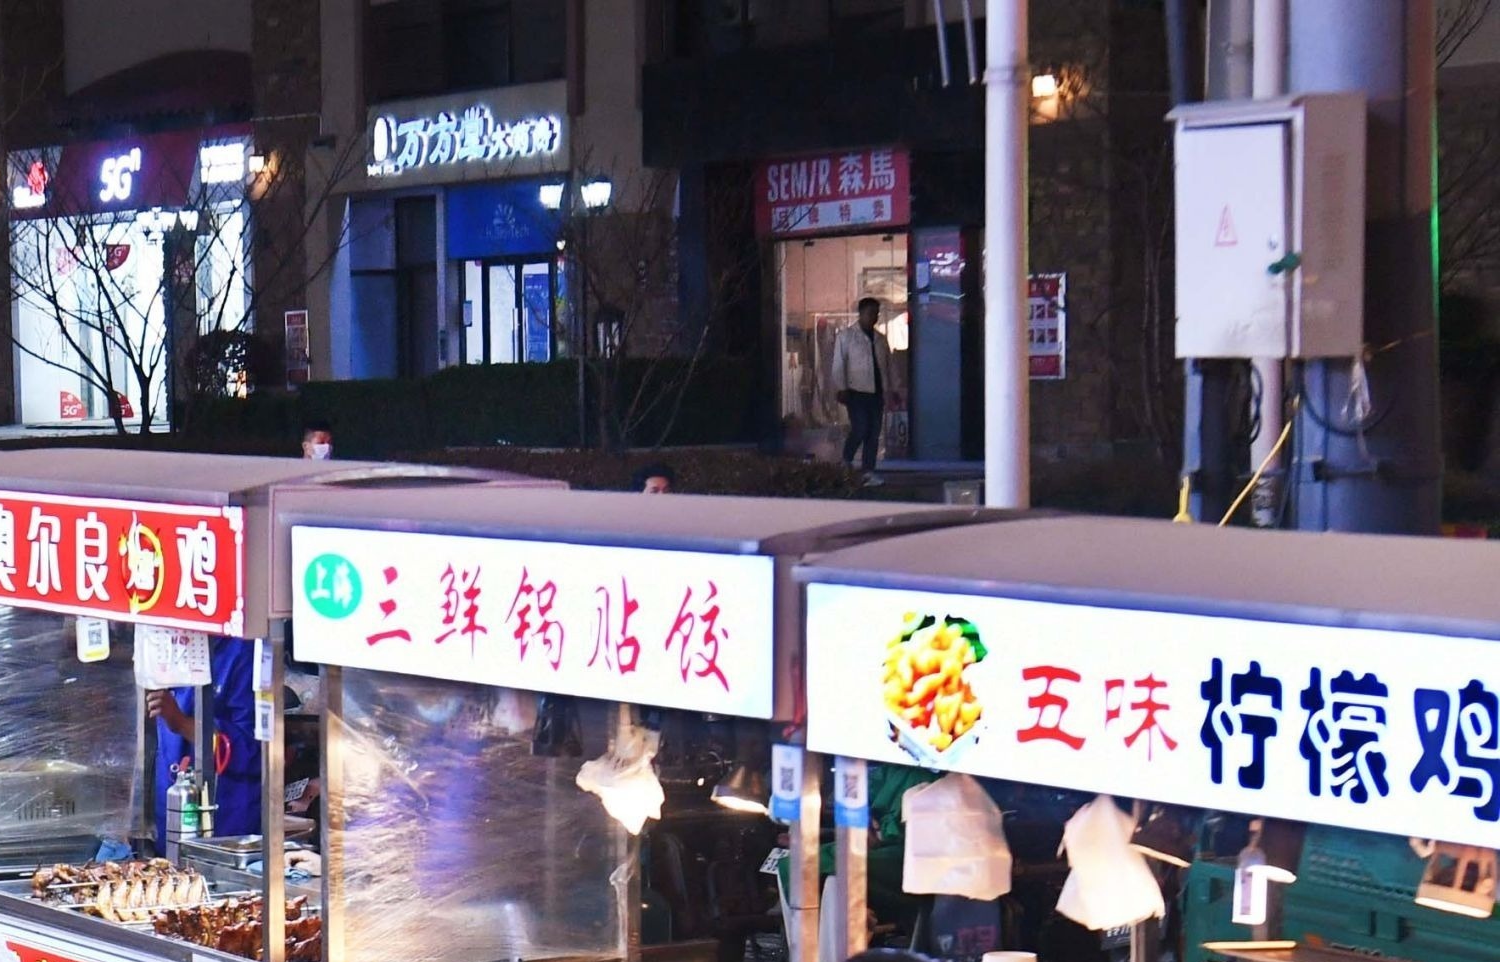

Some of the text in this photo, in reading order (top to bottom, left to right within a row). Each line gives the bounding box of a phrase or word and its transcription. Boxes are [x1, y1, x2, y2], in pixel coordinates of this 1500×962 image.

[366, 562, 730, 693] 三鲜锅贴饺
